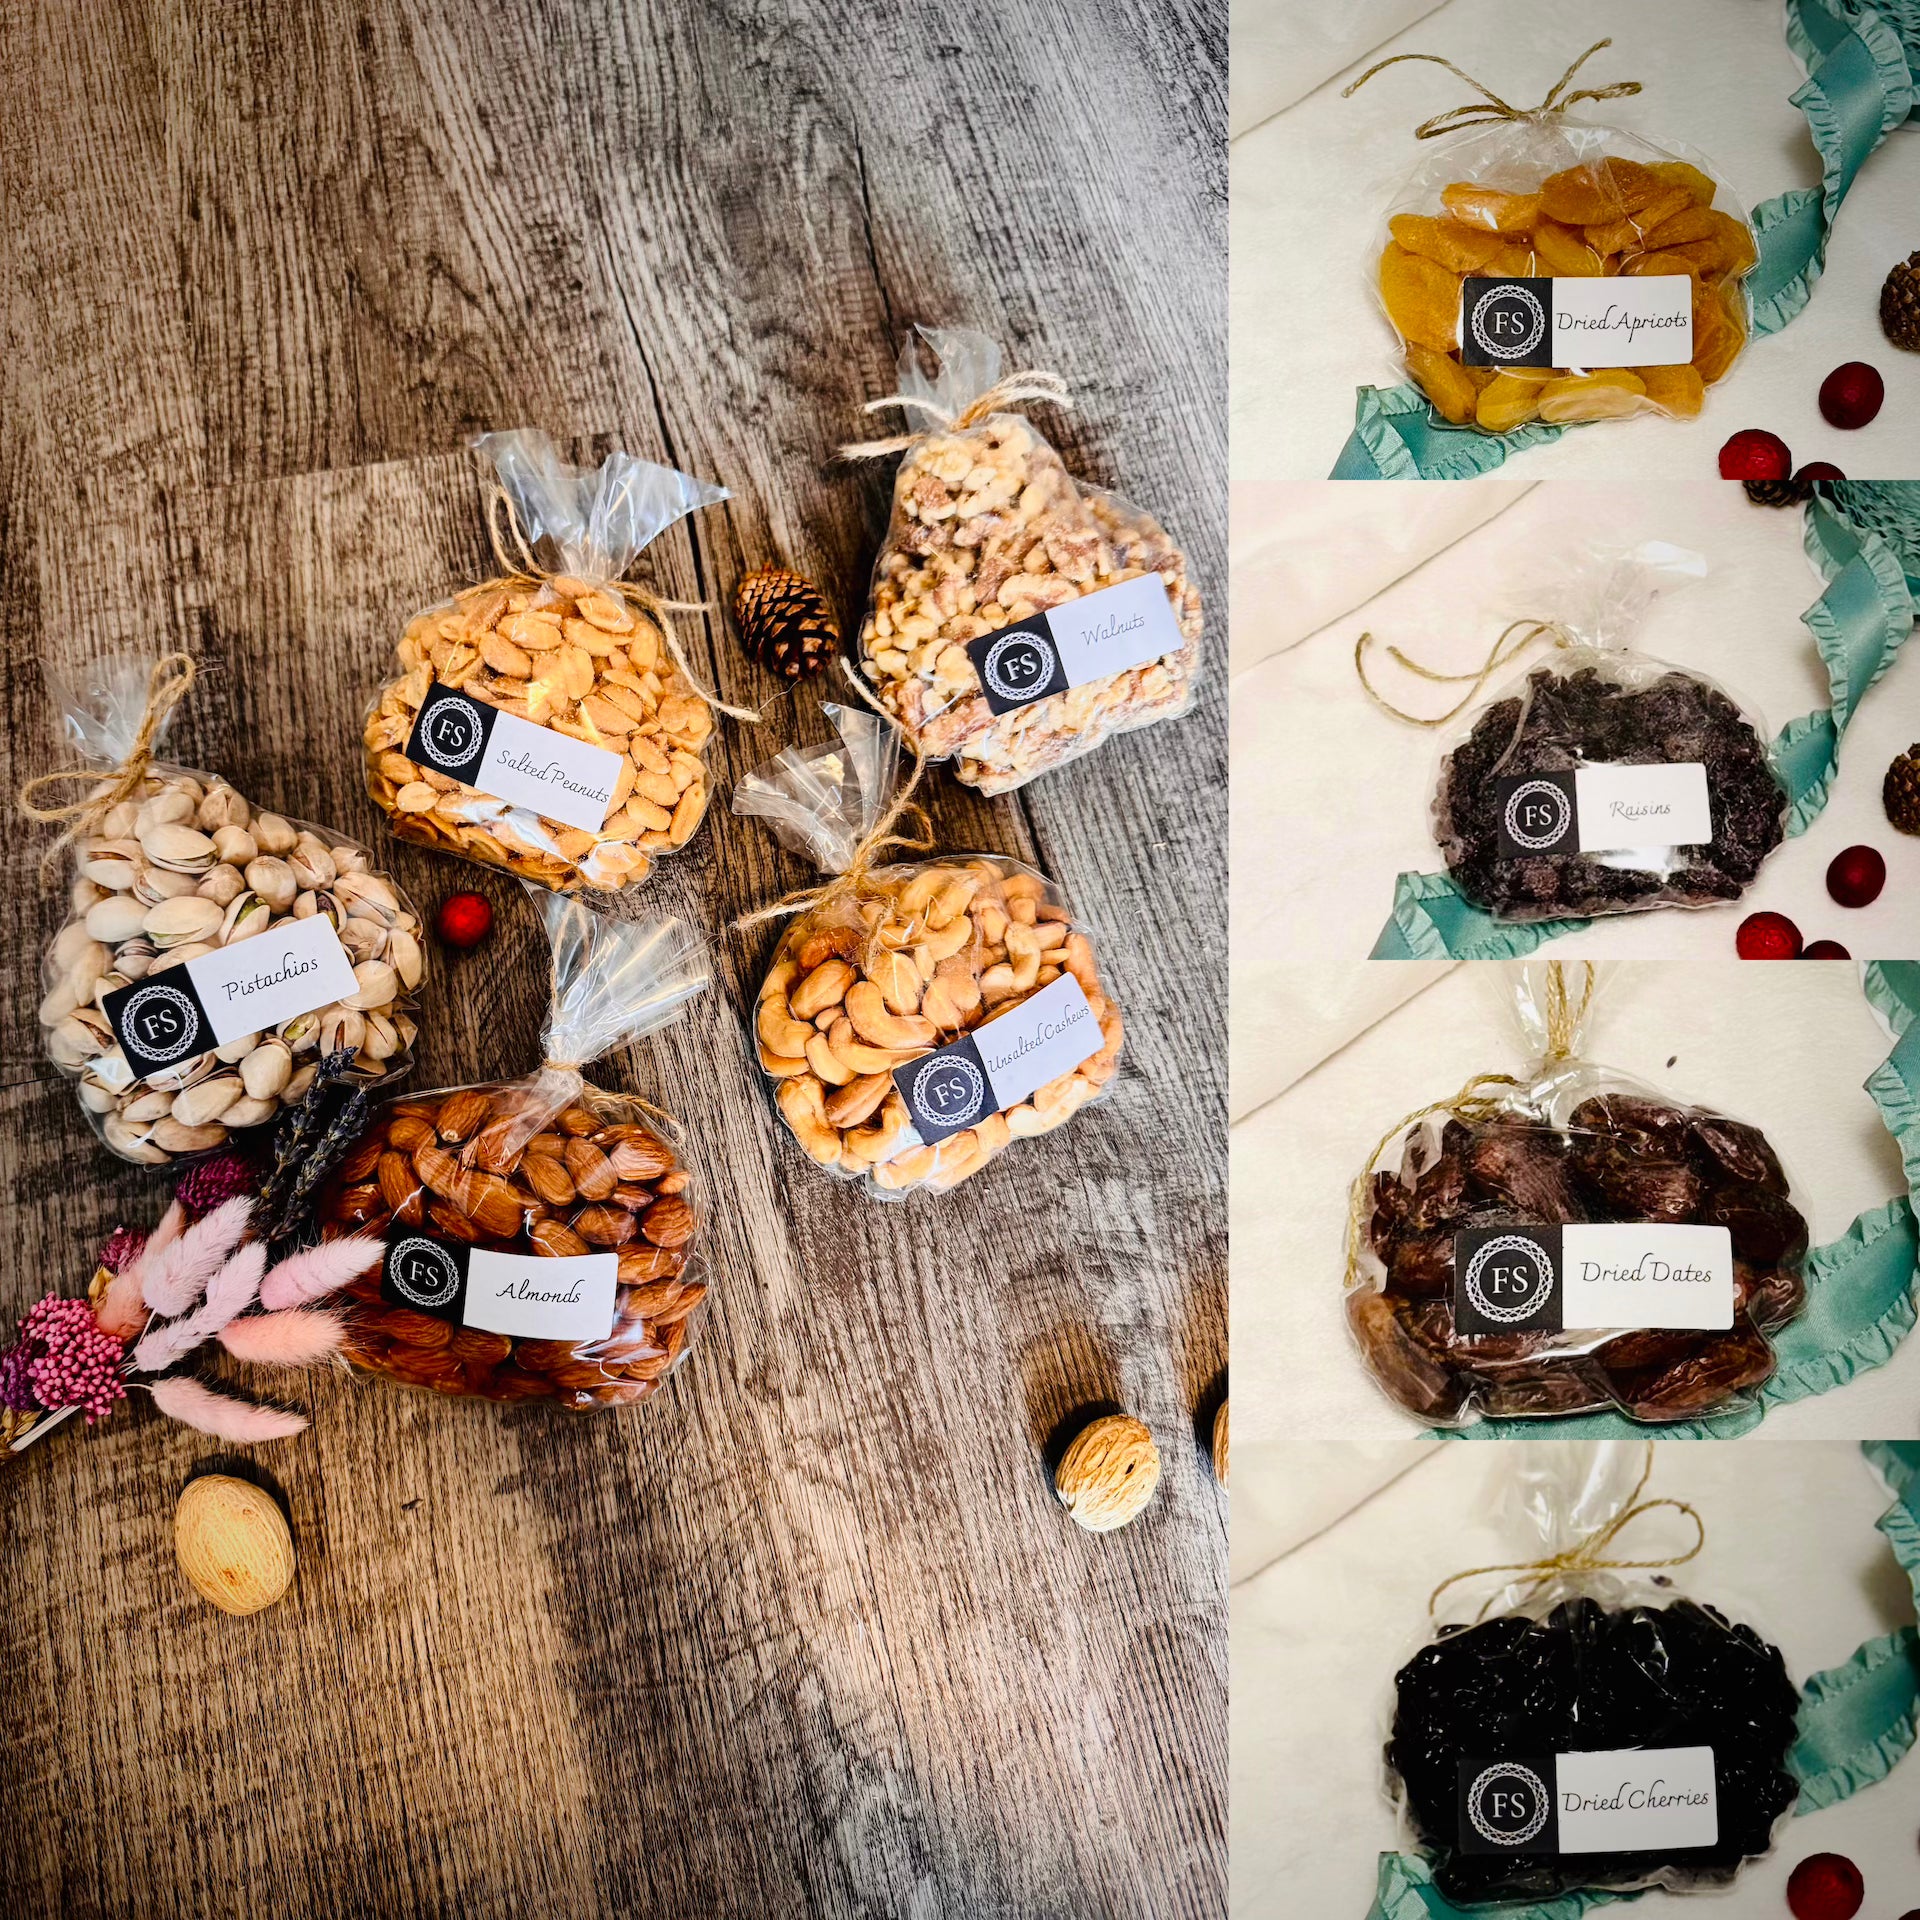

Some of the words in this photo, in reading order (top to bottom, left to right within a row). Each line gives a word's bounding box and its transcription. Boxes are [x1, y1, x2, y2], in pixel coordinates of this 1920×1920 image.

[1494, 311, 1525, 334] FS
[1556, 305, 1618, 330] Dried
[1612, 311, 1688, 343] Apricots
[1080, 613, 1145, 646] Walnuts
[1003, 652, 1038, 682] FS
[436, 719, 466, 747] FS
[496, 750, 559, 781] Salted
[551, 768, 610, 803] Peanuts
[1525, 804, 1553, 827] FS
[1610, 801, 1671, 821] Raisins
[221, 952, 319, 1001] Pistachios
[142, 1009, 178, 1040] FS
[988, 1023, 1044, 1073] Unsalted
[1044, 1004, 1090, 1040] Cashews
[932, 1077, 966, 1108] FS
[409, 1260, 439, 1287] FS
[1492, 1266, 1528, 1294] FS
[1580, 1252, 1655, 1282] Dried
[1650, 1261, 1712, 1283] Dates
[495, 1279, 586, 1304] Almonds
[1492, 1792, 1526, 1819] FS
[1562, 1782, 1631, 1812] Dried
[1628, 1779, 1710, 1809] Cherries
